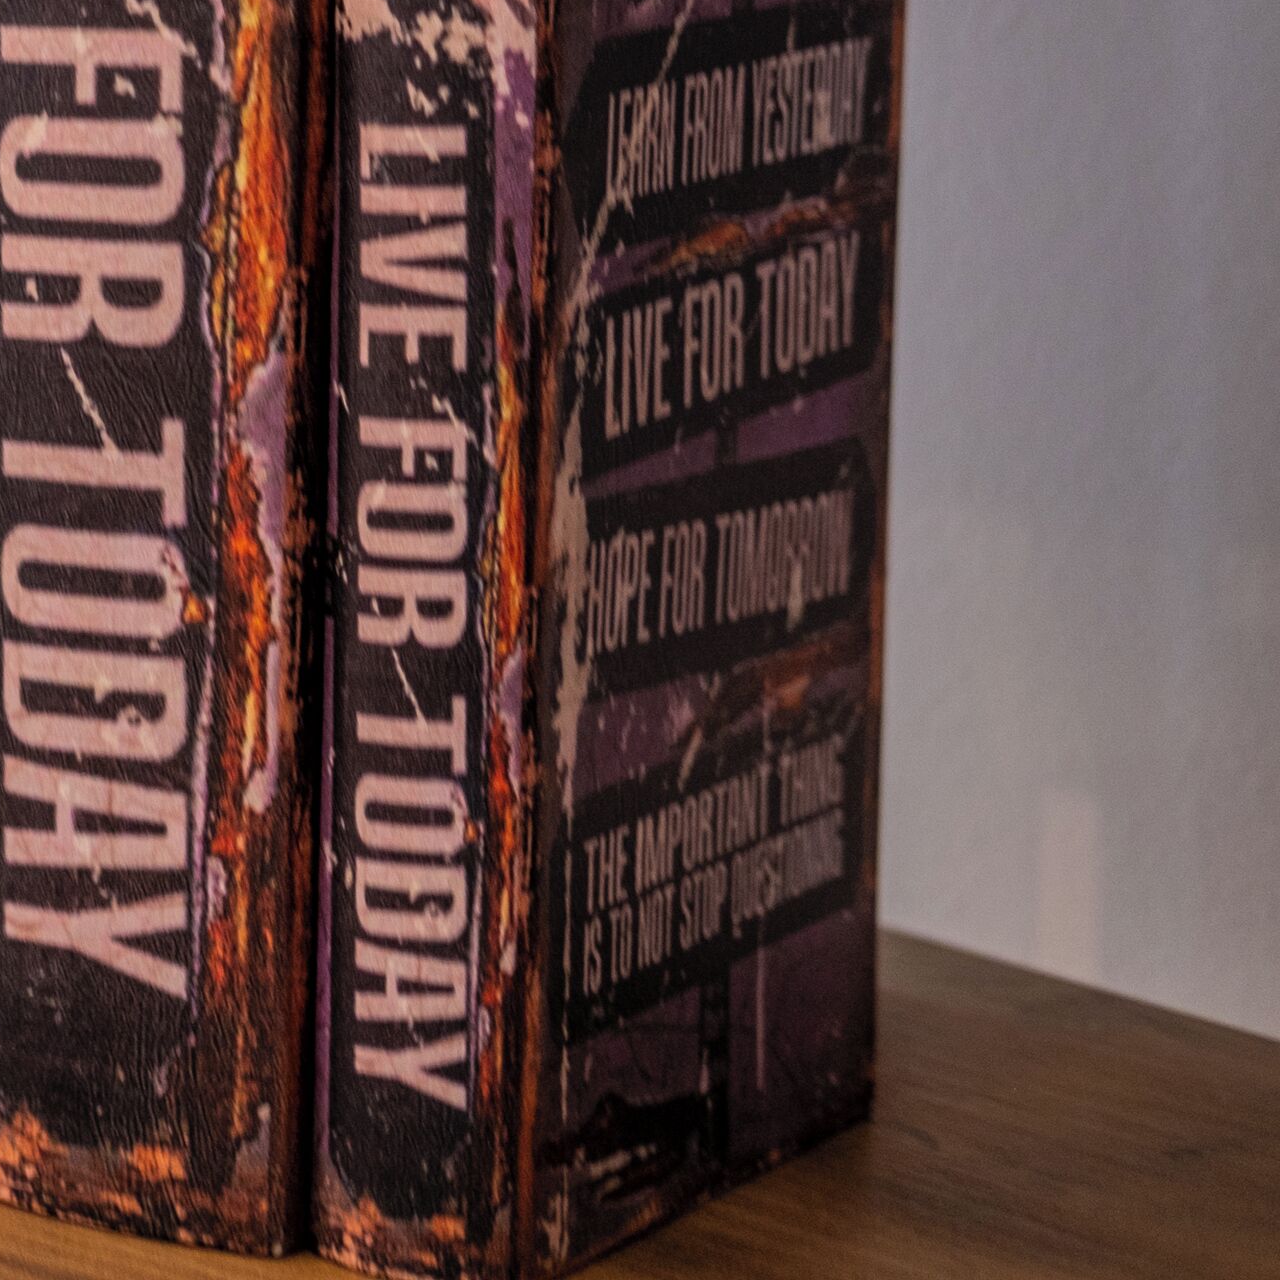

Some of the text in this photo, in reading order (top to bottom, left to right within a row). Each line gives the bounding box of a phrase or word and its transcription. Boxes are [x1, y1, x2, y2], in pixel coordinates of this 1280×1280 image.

[605, 35, 873, 205] LEARN FROM YESTERDAY
[604, 230, 860, 442] LIVE FOR TODAY
[353, 123, 469, 1112] LIVE FOR TODAY
[586, 527, 655, 655] HOPE
[658, 518, 707, 639] FOR
[0, 417, 189, 1001] TODAY
[583, 823, 629, 916] THE
[635, 763, 770, 894] IMPORTANT
[583, 916, 602, 997] IS
[609, 902, 633, 985] TO
[638, 882, 676, 969] NOT
